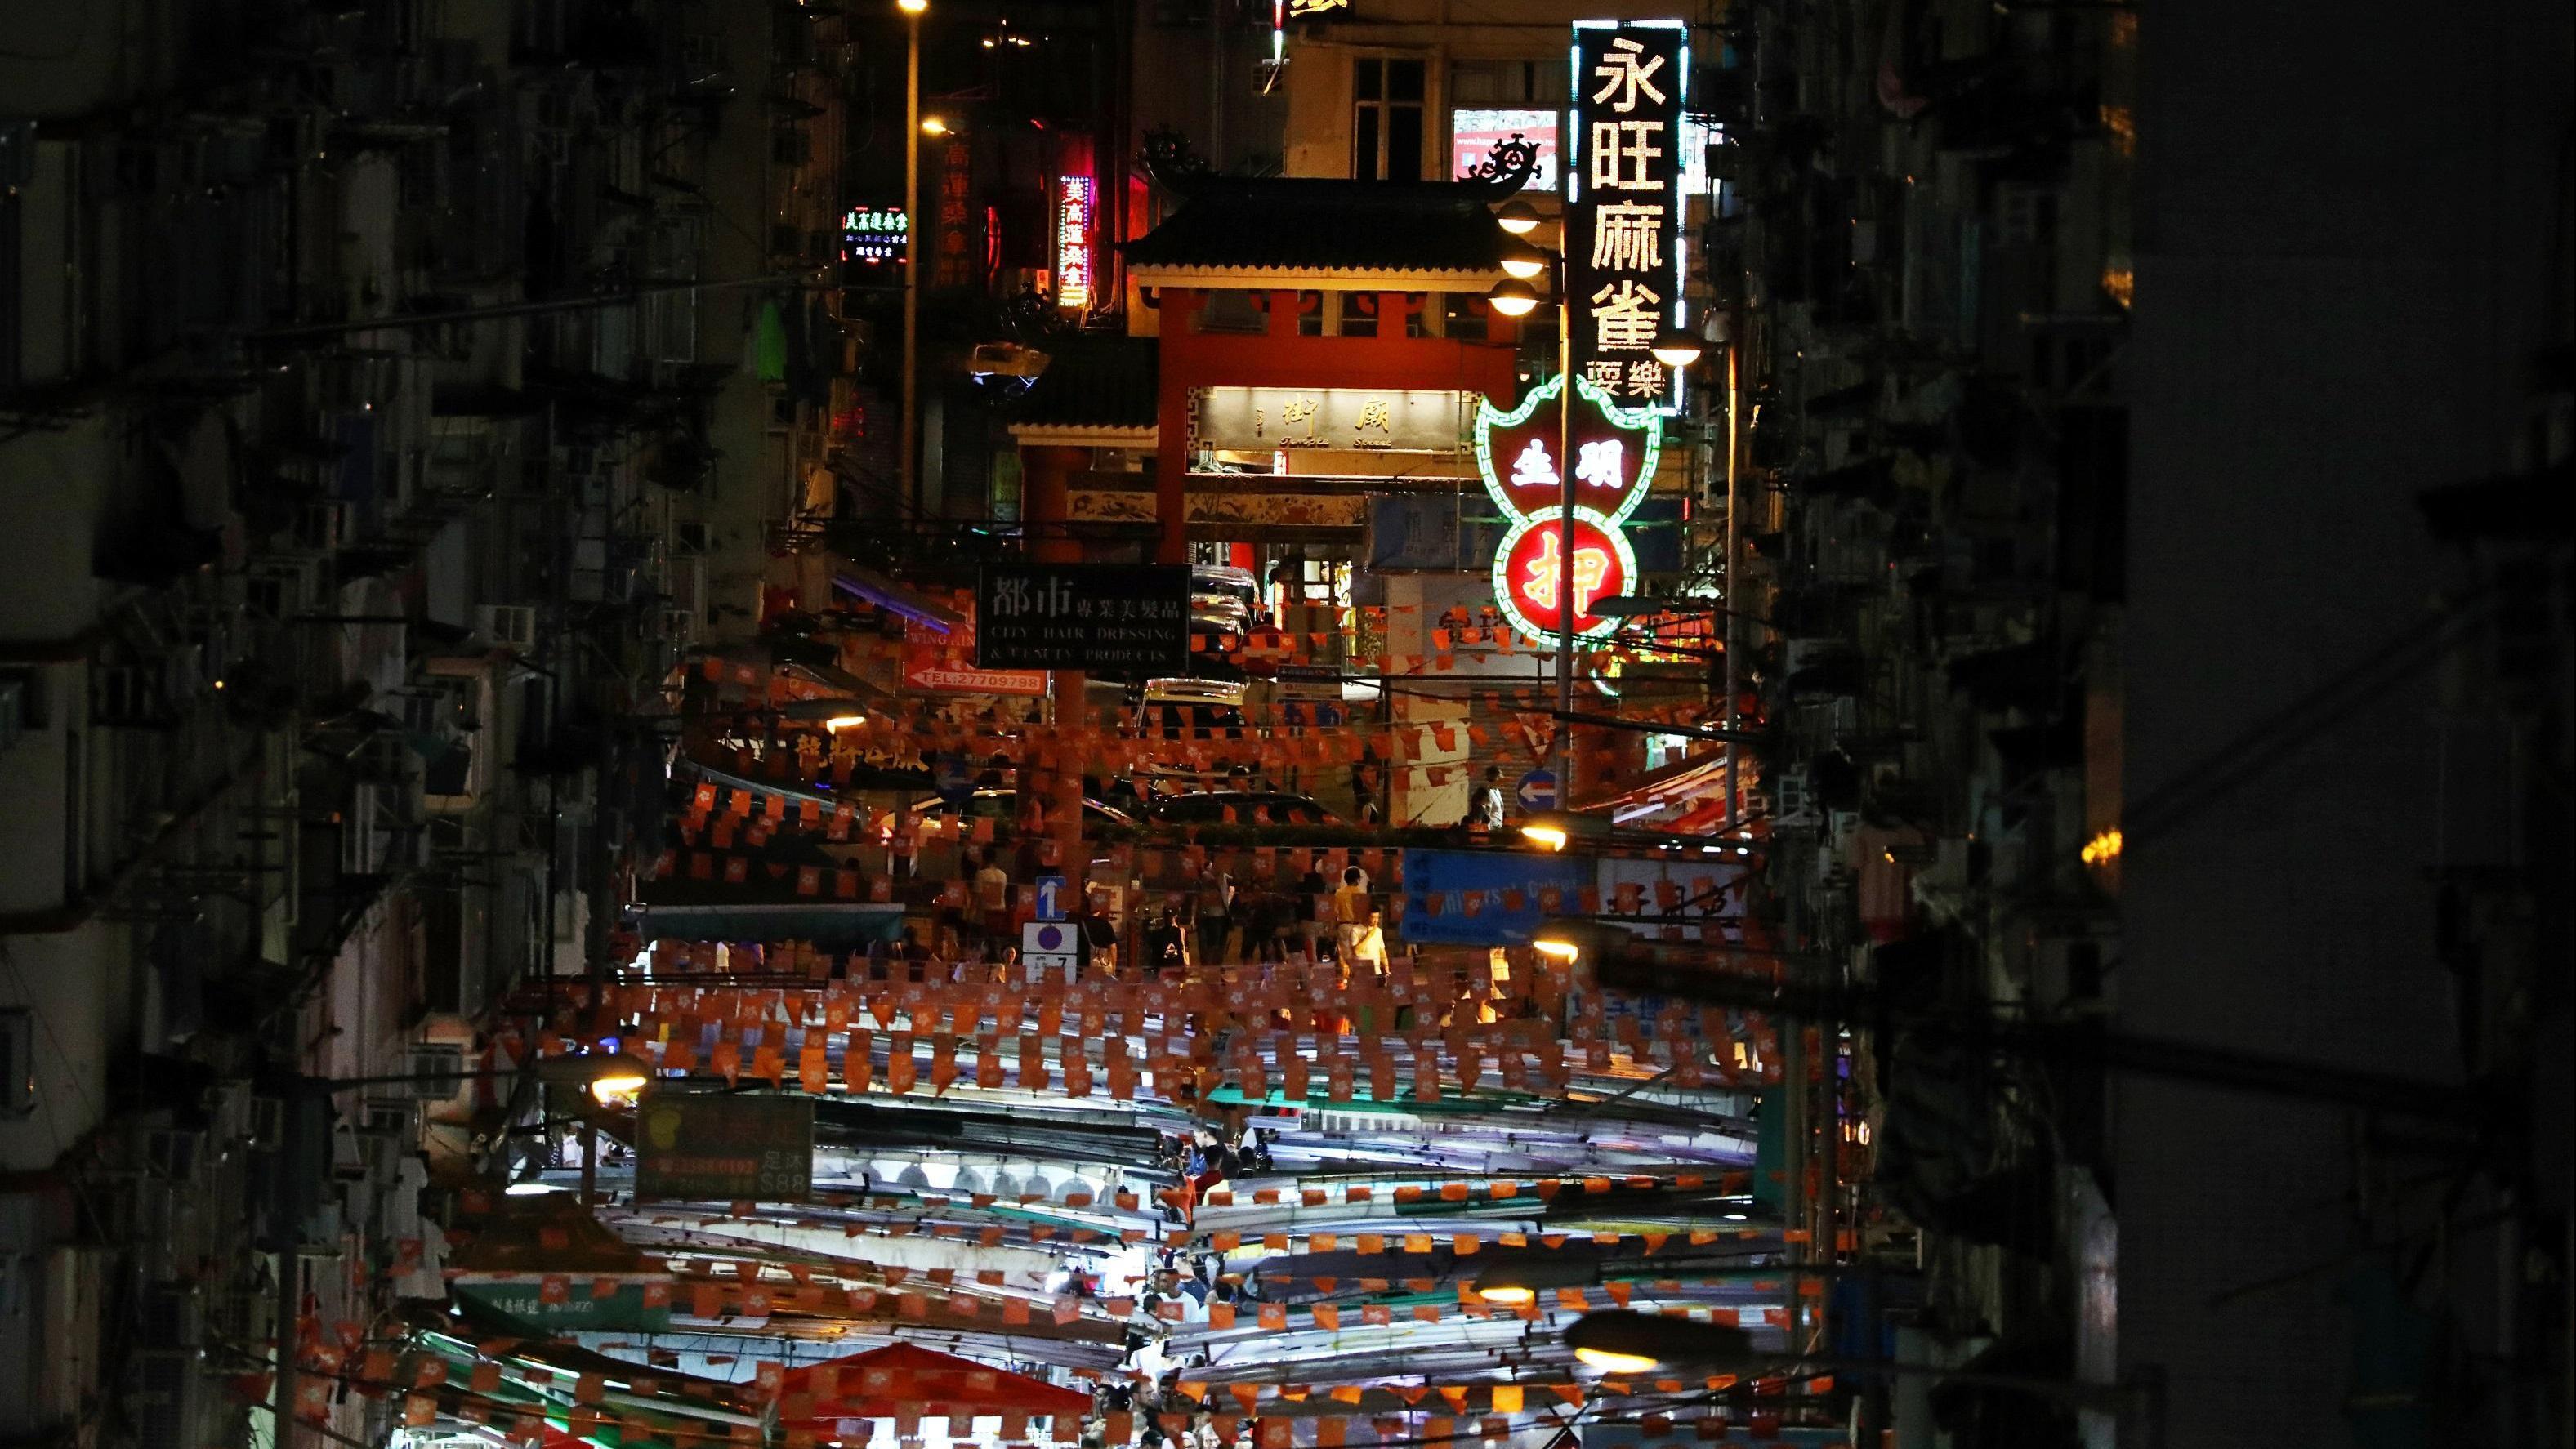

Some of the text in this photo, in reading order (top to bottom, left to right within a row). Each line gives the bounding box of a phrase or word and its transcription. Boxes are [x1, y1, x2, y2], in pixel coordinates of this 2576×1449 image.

[1592, 38, 1667, 353] 永旺麻雀
[1279, 437, 1329, 448] Temple
[1524, 531, 1609, 618] 押
[991, 627, 1176, 641] CITY HAIR DRESSING
